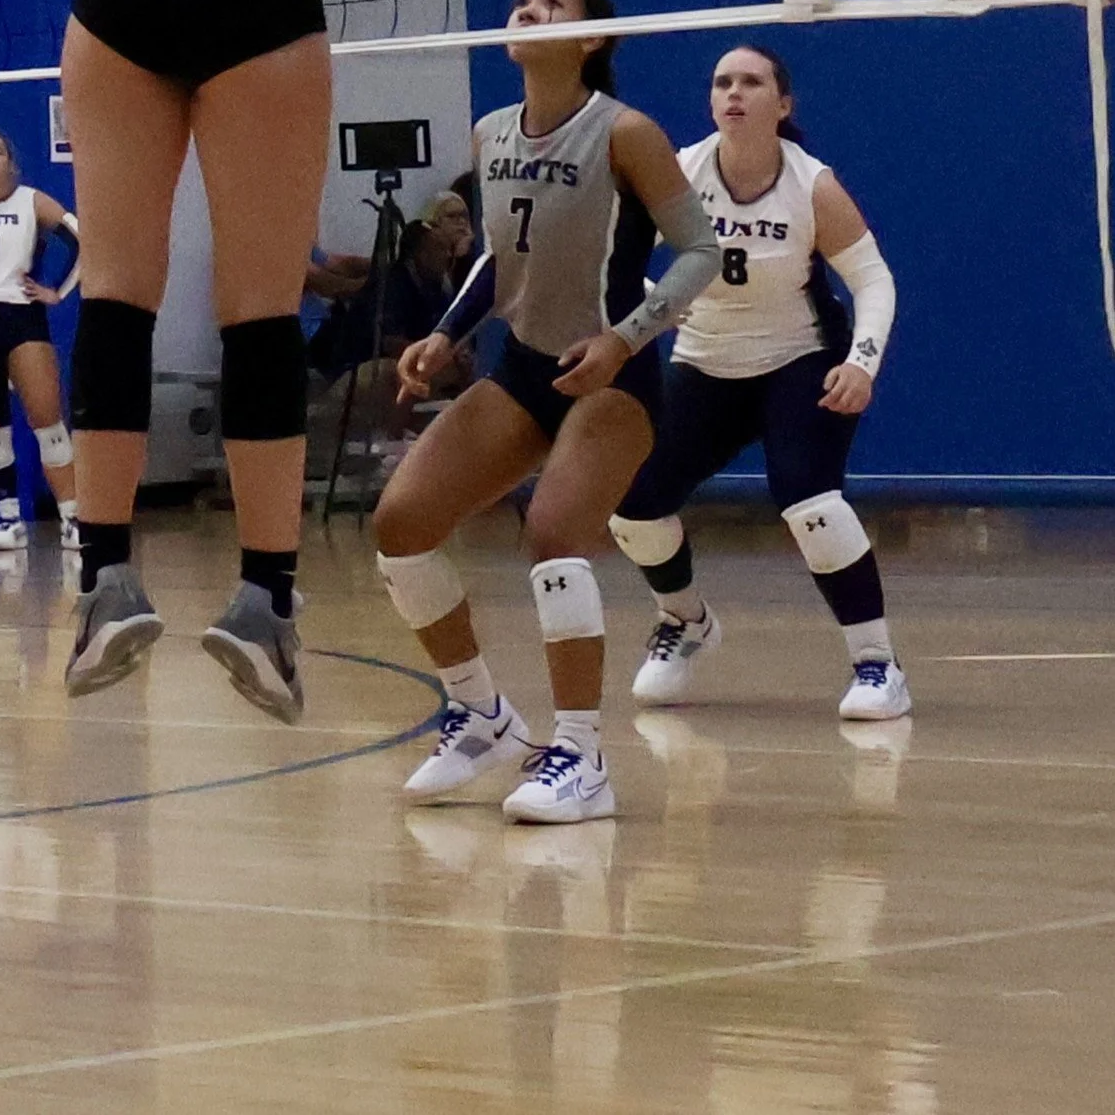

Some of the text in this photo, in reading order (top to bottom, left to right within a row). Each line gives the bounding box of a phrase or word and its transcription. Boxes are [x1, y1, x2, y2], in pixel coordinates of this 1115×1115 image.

[487, 157, 579, 187] SAINTS
[510, 197, 534, 253] 7
[708, 215, 788, 240] AINTS
[722, 247, 749, 285] 8
